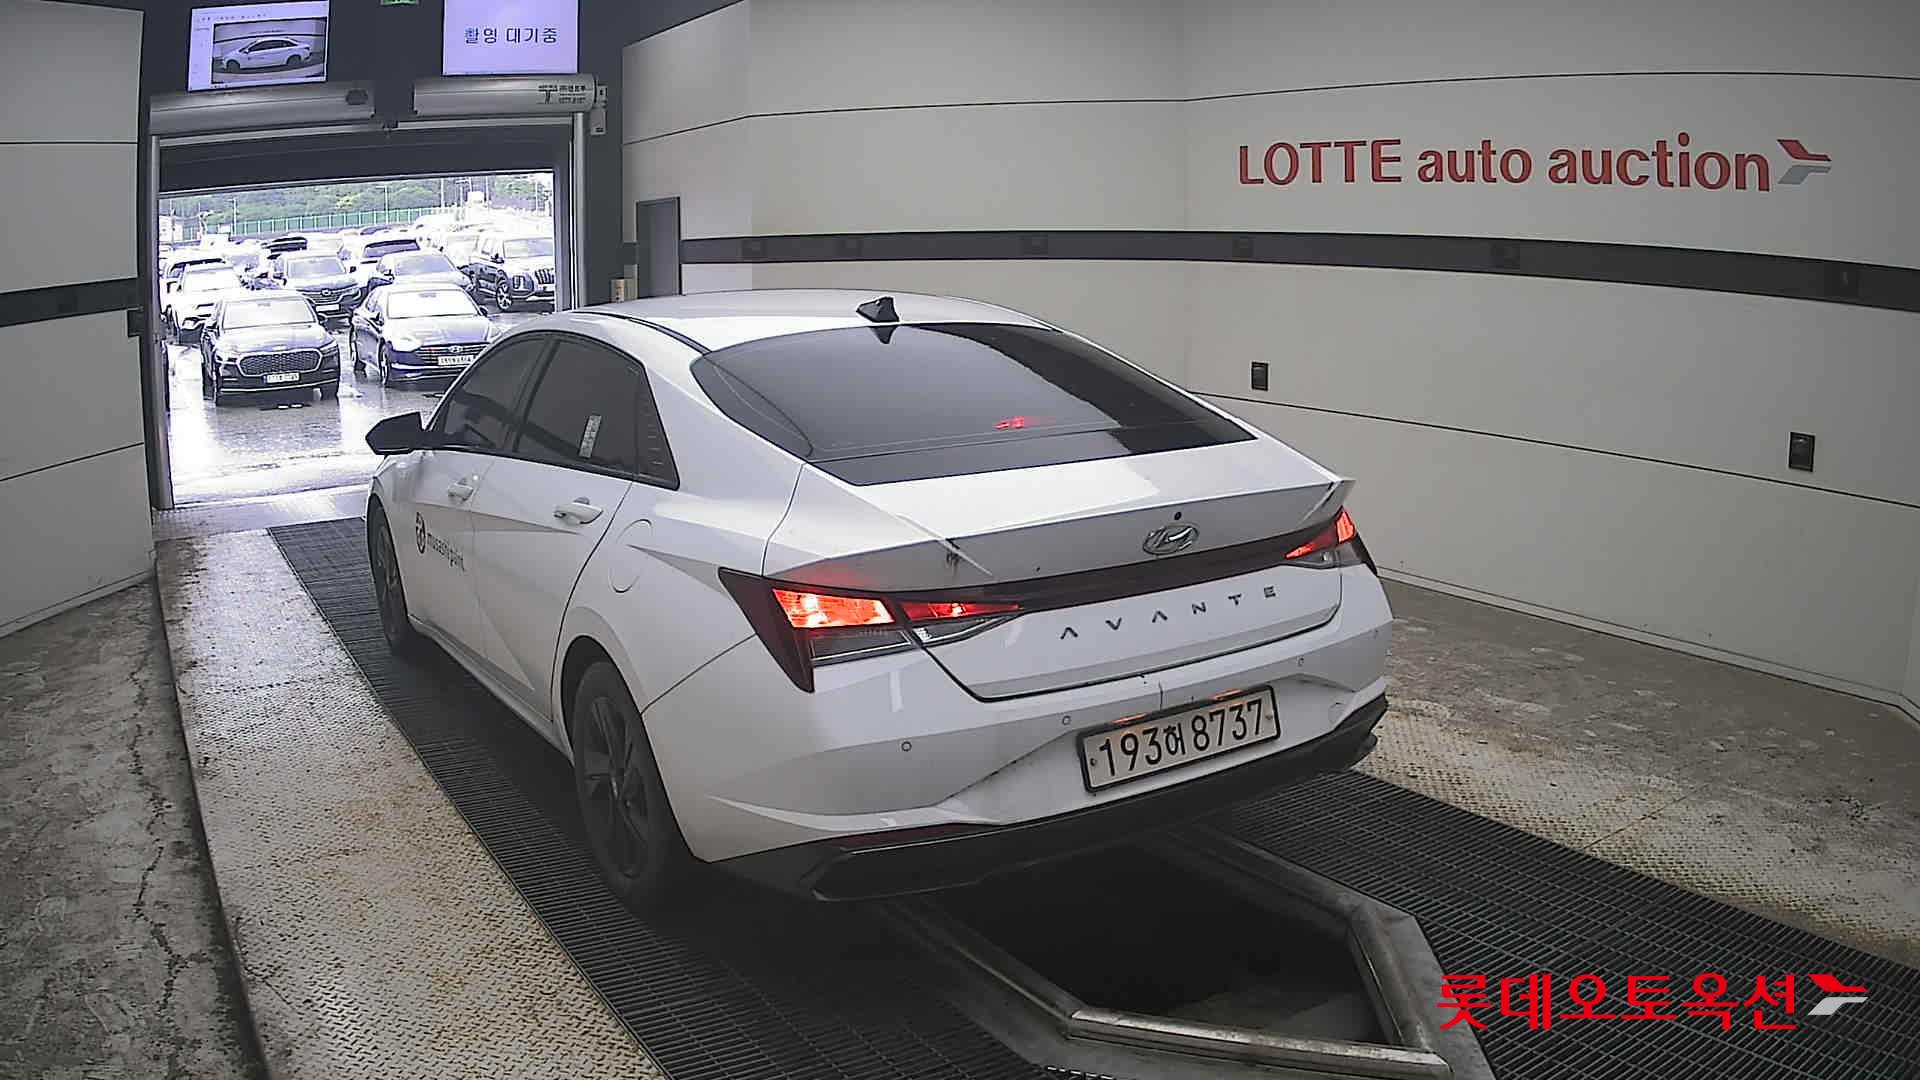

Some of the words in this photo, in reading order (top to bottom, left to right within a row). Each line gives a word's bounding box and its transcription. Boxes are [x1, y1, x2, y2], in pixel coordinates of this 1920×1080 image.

[505, 27, 558, 44] 대기중
[1239, 139, 1401, 185] LOTTE
[1417, 140, 1533, 184] auto
[1548, 132, 1771, 193] auction
[1059, 585, 1277, 640] AVANTE
